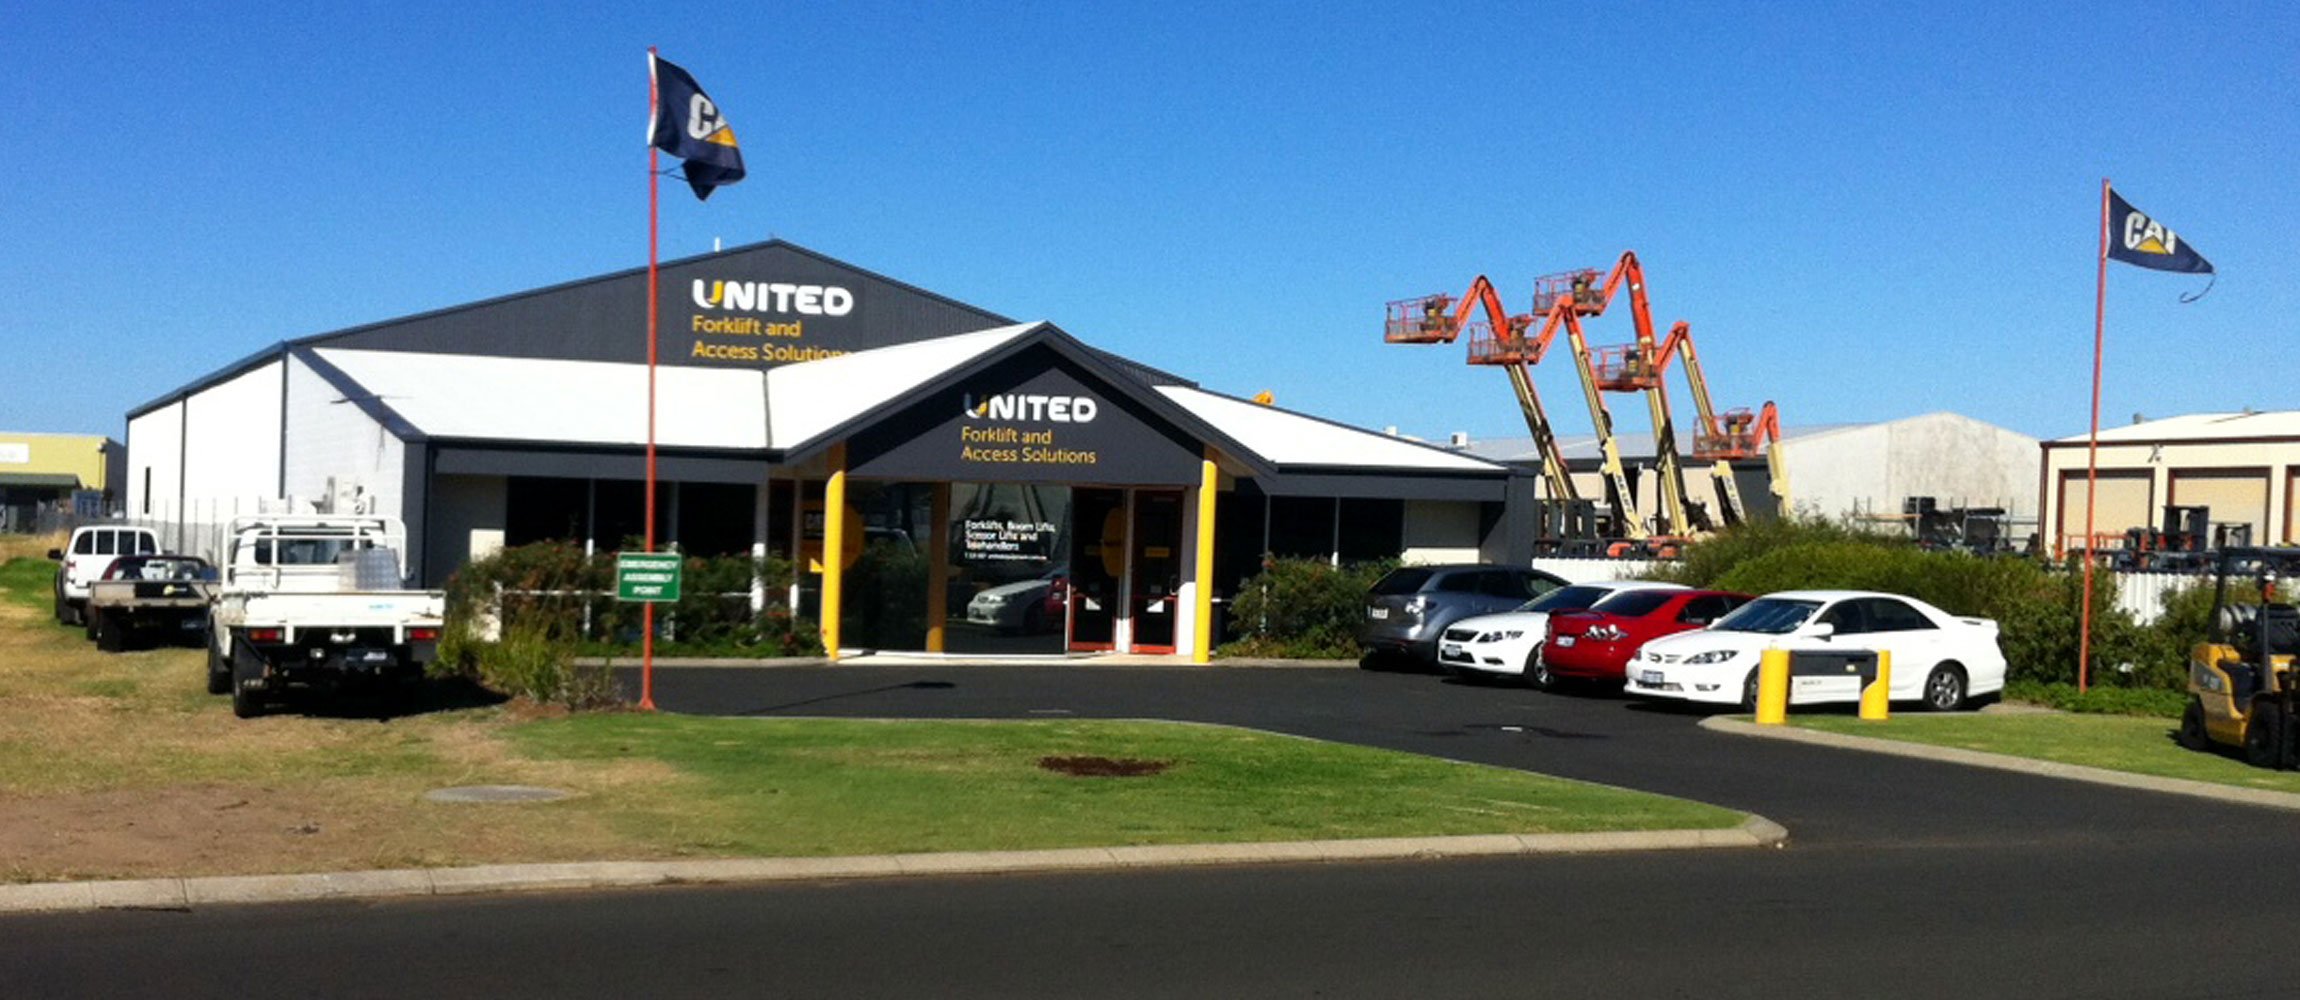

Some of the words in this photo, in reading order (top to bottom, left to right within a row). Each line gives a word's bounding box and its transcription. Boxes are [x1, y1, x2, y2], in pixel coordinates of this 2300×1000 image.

[693, 279, 853, 316] UNITED
[692, 315, 761, 335] Forklift
[765, 320, 801, 337] and
[692, 340, 757, 360] Access
[963, 393, 1097, 422] UNITED
[962, 426, 1018, 442] Forklift
[1022, 429, 1052, 444] and
[961, 445, 1017, 461] Access
[1022, 447, 1096, 463] Solutions
[620, 560, 678, 569] EMERGENCY
[623, 573, 673, 582] ASSEMBLY
[632, 586, 663, 595] POINT
